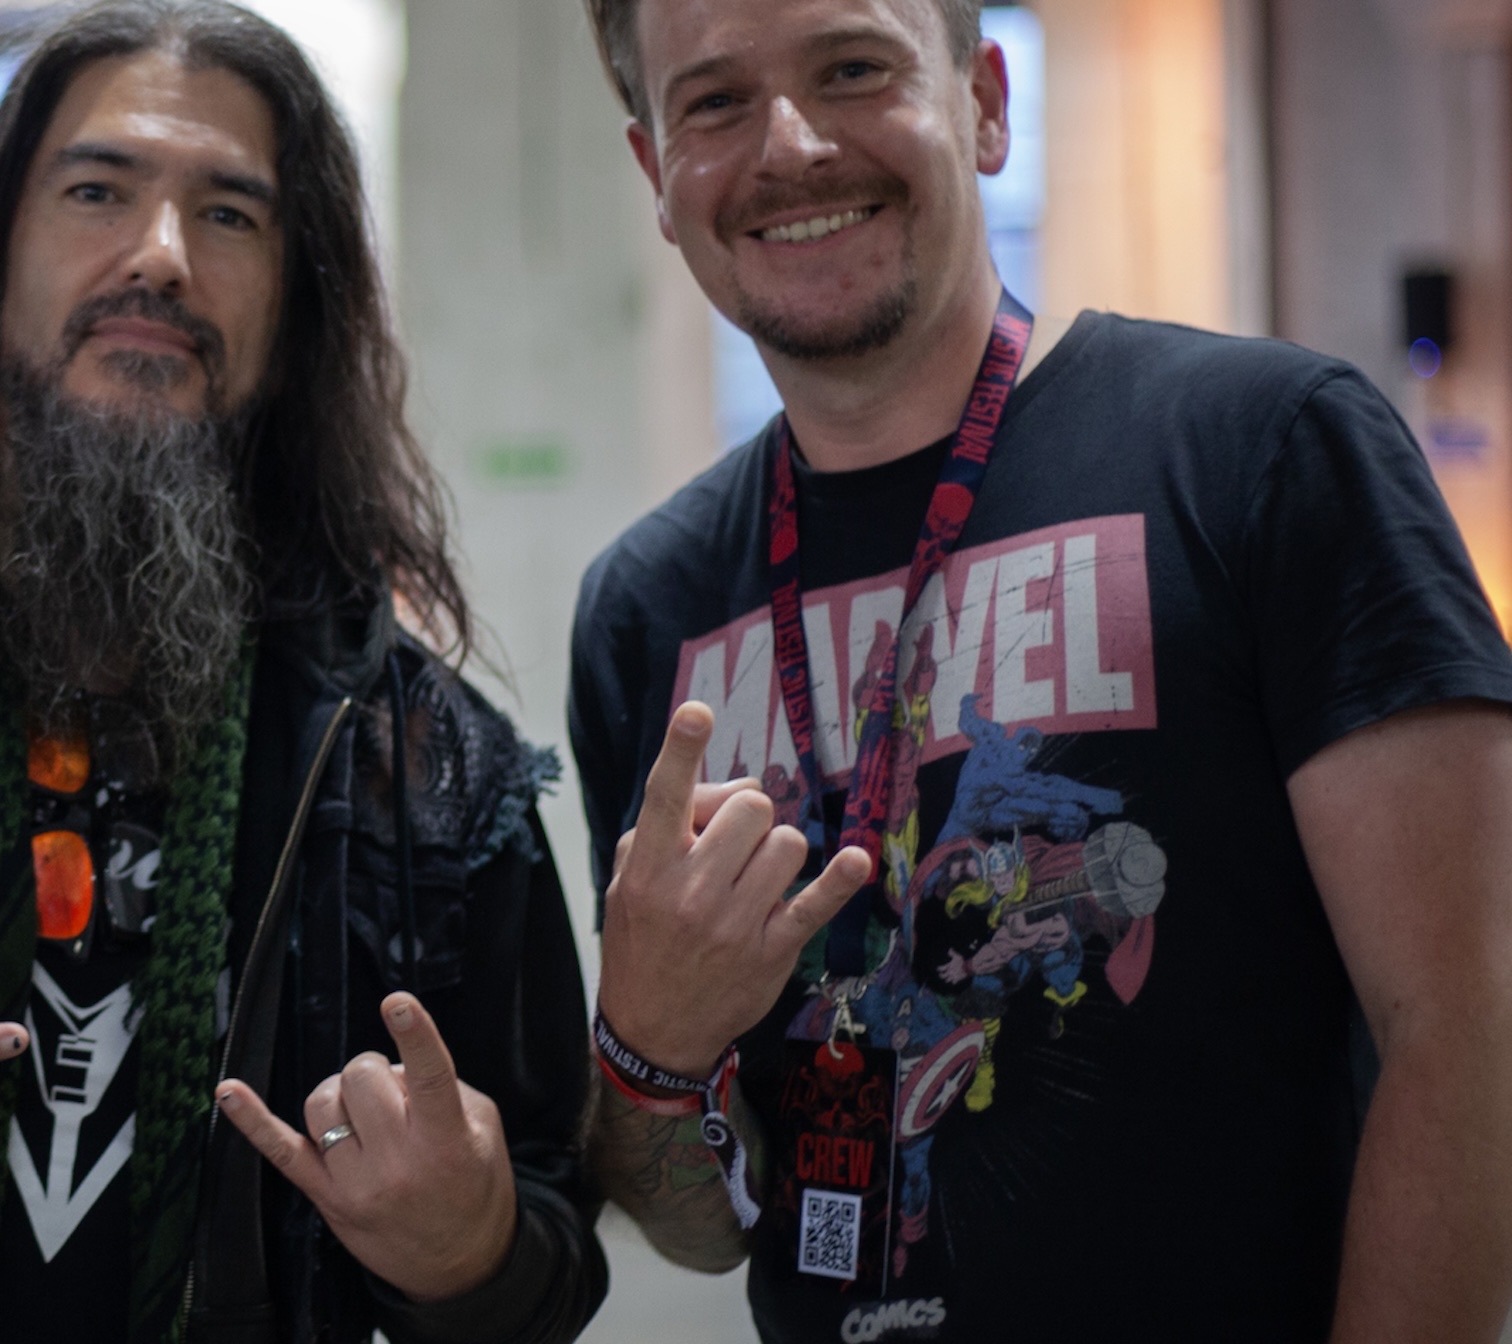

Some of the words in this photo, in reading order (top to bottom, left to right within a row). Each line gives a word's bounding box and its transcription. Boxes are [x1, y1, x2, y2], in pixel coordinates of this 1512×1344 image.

[982, 312, 1032, 383] MYSTIC
[951, 381, 1011, 466] FESTIVAL
[771, 577, 808, 673] FESTIVAL
[781, 666, 814, 757] MYSTIC
[596, 1018, 649, 1081] FESTIVAL
[795, 1130, 876, 1190] CREW
